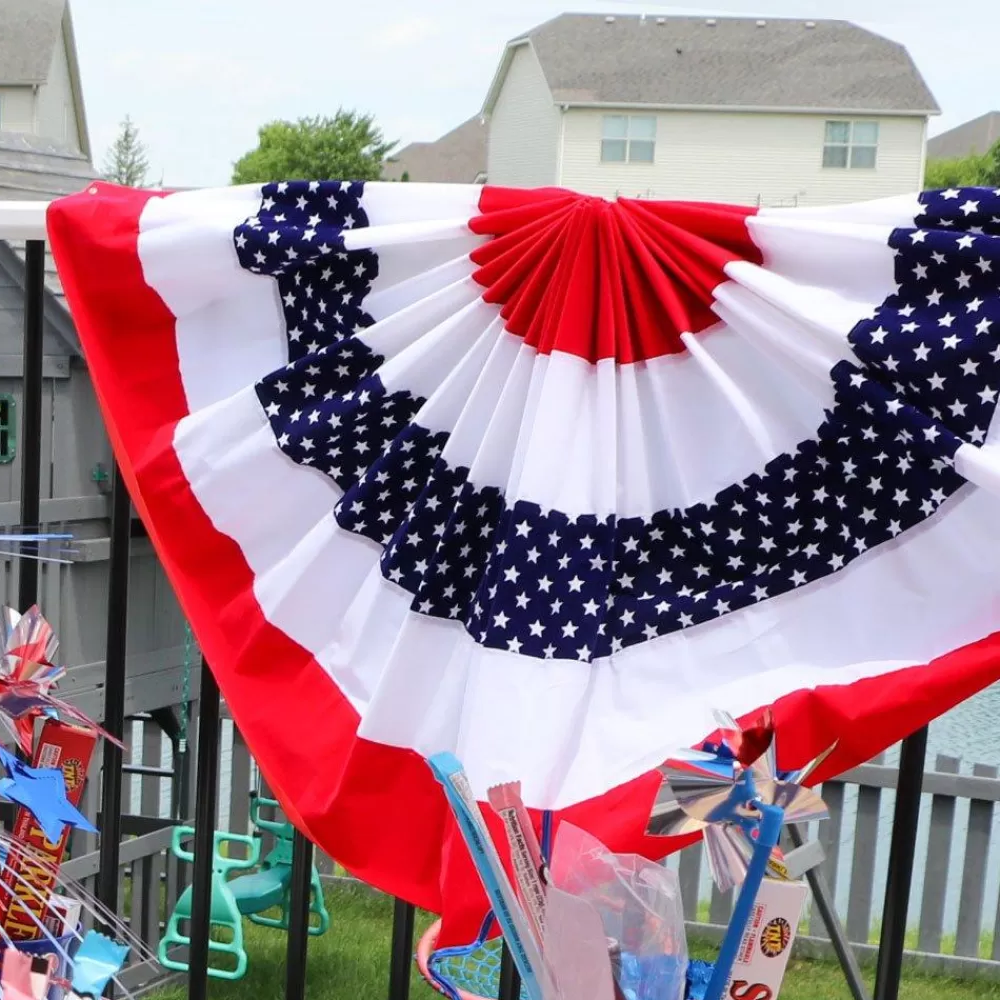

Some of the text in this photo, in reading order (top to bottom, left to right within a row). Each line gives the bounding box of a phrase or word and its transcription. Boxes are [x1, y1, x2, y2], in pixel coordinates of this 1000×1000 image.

[507, 809, 520, 834] Nutrition
[516, 834, 526, 851] Facts
[767, 924, 784, 952] TNT
